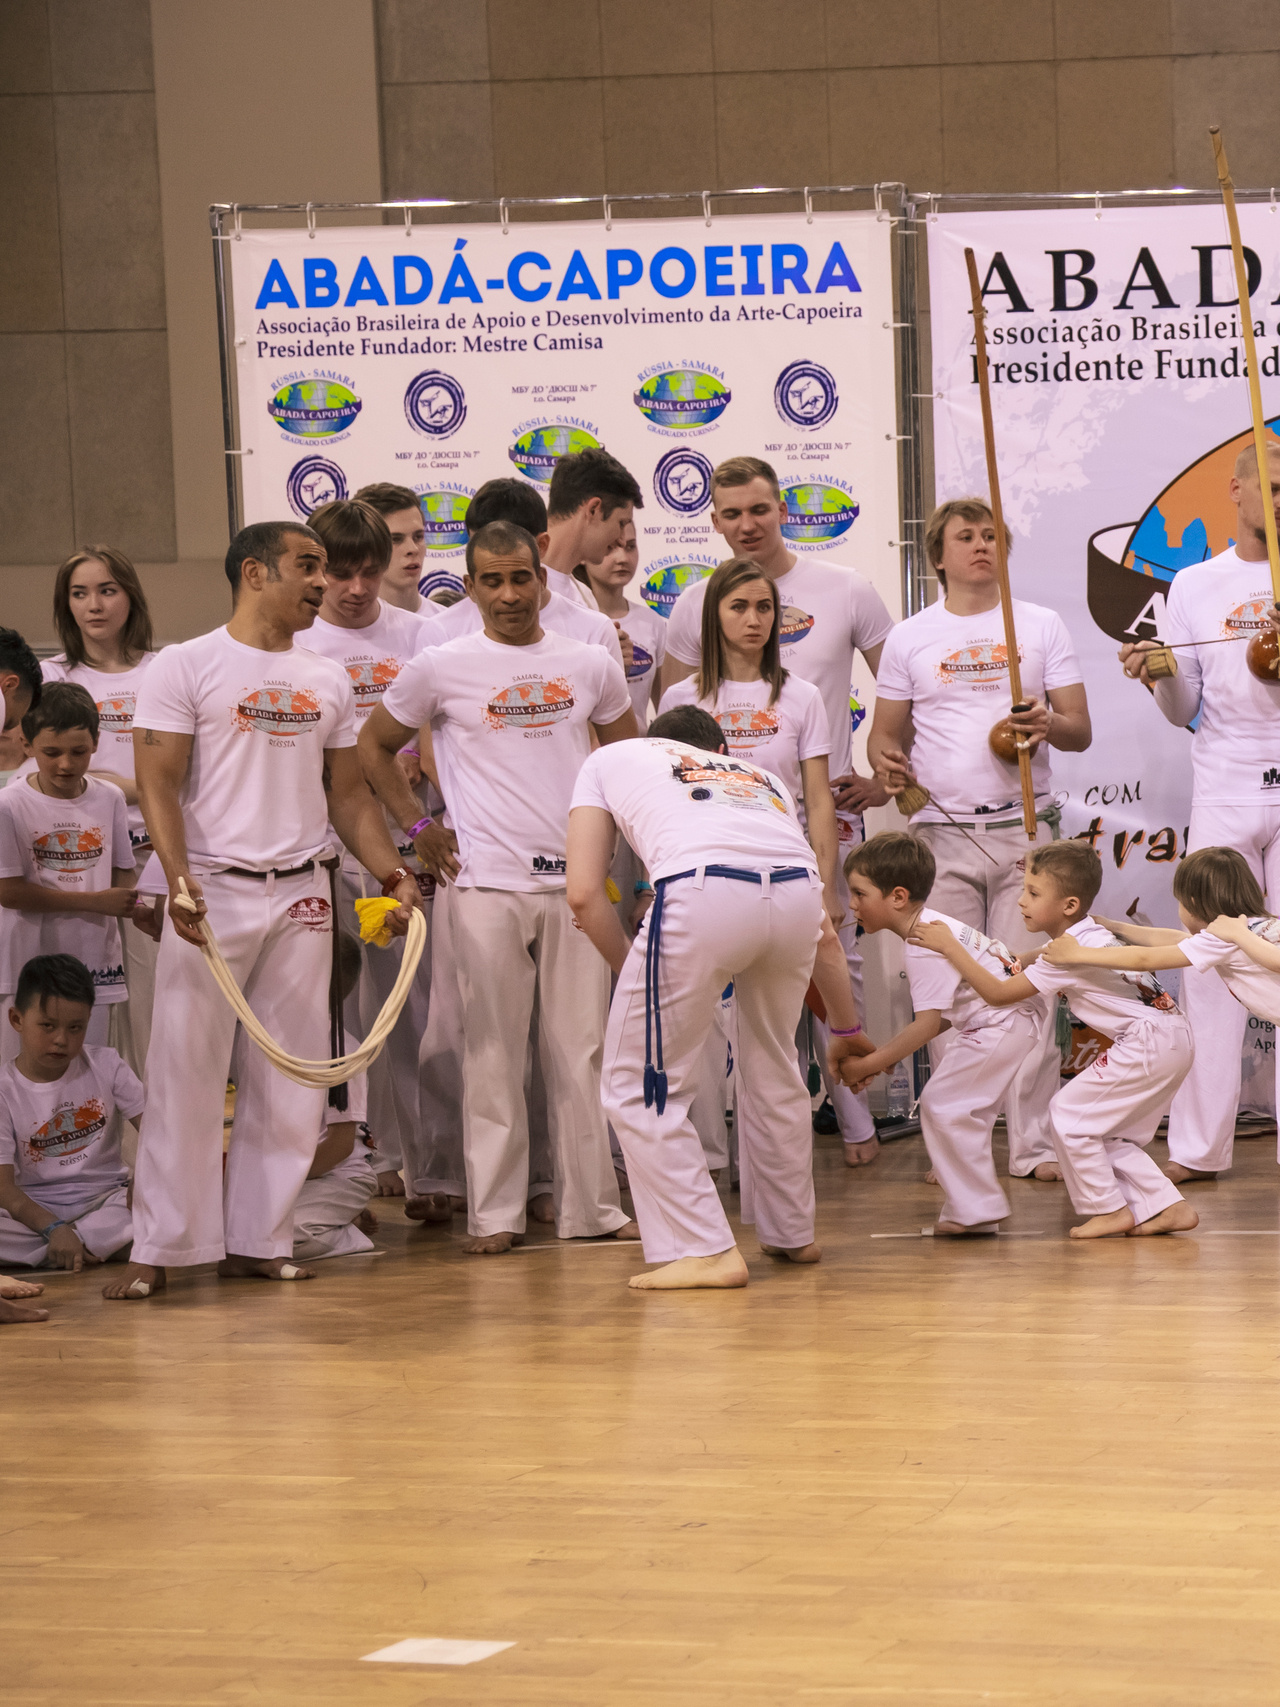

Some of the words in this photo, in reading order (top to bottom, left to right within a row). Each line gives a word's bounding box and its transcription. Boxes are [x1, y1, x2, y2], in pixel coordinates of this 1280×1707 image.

[255, 238, 862, 309] ABADÁ-CAPOEIRA
[256, 317, 350, 337] Associação
[356, 314, 440, 333] Brasileira
[445, 313, 467, 330] de
[472, 311, 526, 333] Apoio
[531, 316, 541, 327] e
[546, 305, 704, 327] Desenvolvimento
[709, 305, 730, 322] da
[736, 302, 863, 325] Arte-Capoeira
[1130, 312, 1266, 341] Brasileia
[256, 338, 355, 358] Presidente
[360, 336, 457, 357] Fundador:
[462, 334, 528, 353] Mestre
[533, 332, 604, 351] Camisa
[271, 370, 306, 391] RÚSSIA
[313, 368, 356, 390] SAMARA
[637, 361, 673, 382] RÚSSIA
[681, 359, 725, 380] SAMARA
[512, 416, 548, 437] RÚSSIA
[556, 414, 600, 436] SAMARA
[440, 480, 477, 497] SAMAR
[779, 474, 802, 488] SSIA
[809, 473, 853, 494] SAMARA
[788, 511, 855, 525] DÁ-CAPOEIRA
[644, 554, 680, 576] RÚSSIA
